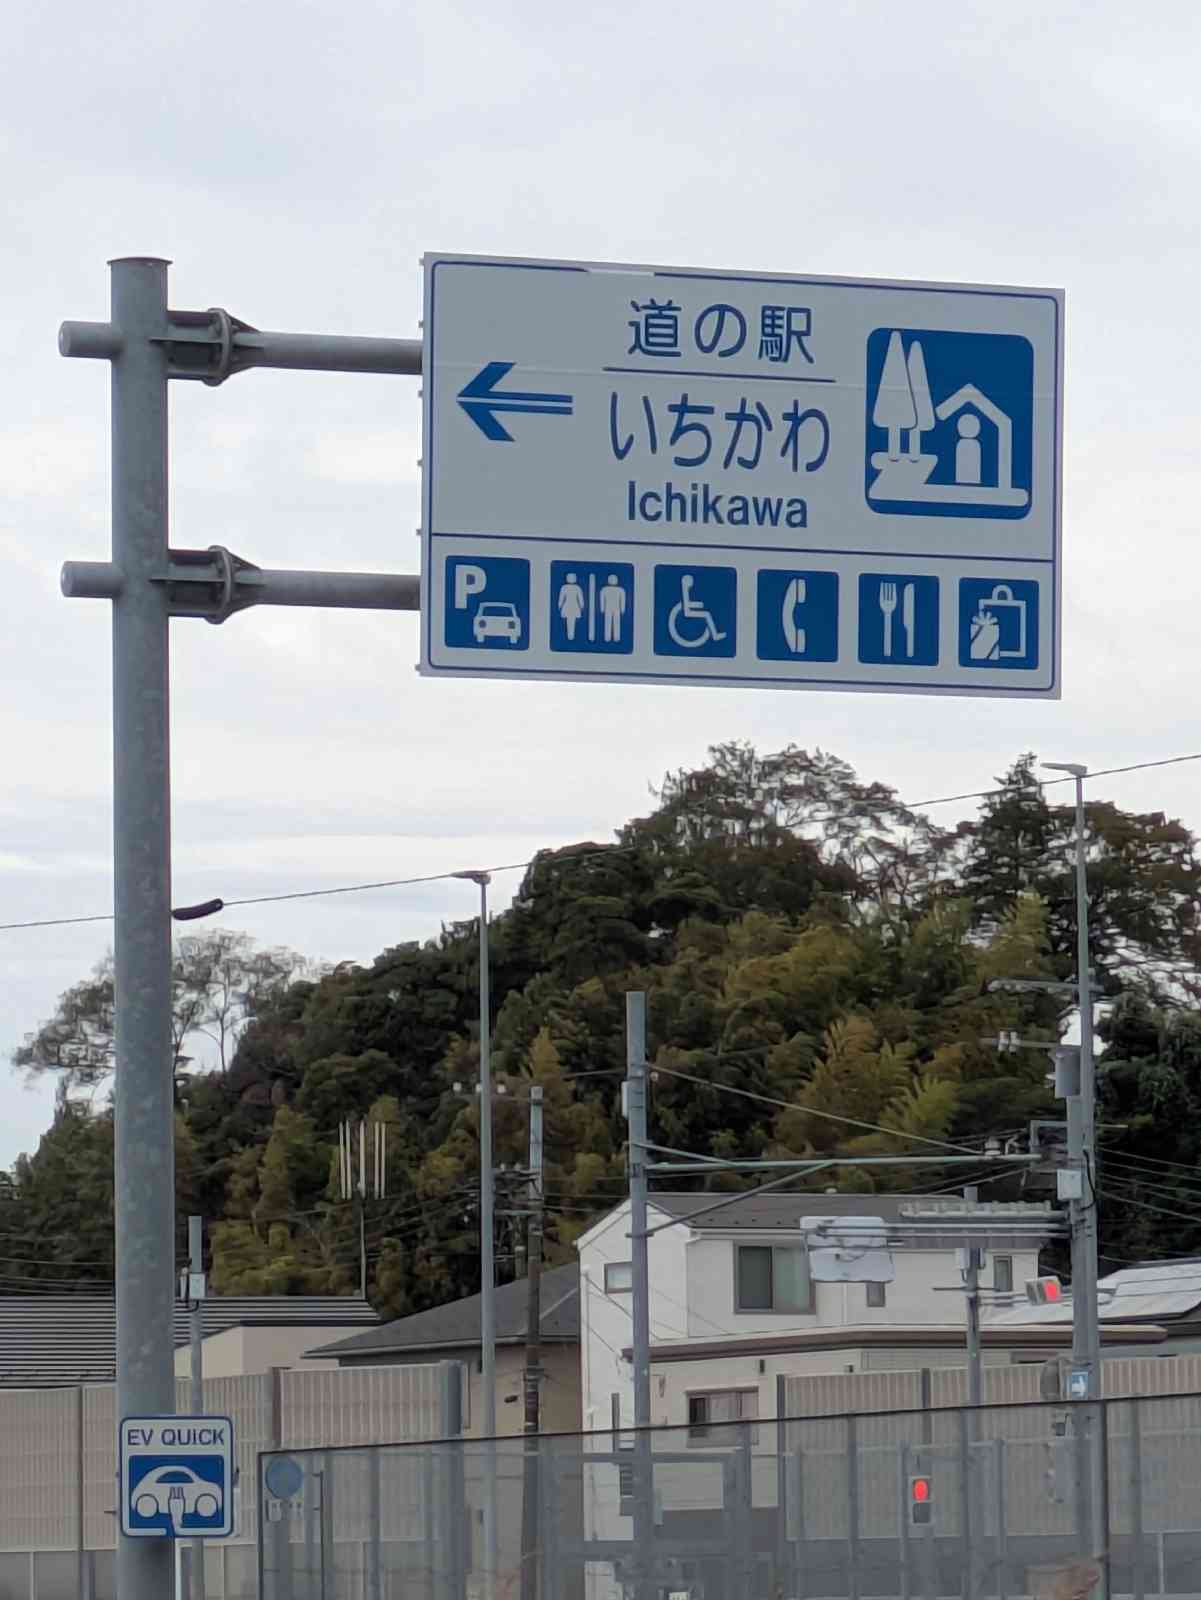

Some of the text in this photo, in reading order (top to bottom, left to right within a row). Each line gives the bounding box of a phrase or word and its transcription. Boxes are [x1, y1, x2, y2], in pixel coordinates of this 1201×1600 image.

[627, 298, 815, 364] 道の駅
[609, 391, 831, 473] いちかわ
[627, 480, 809, 529] Ichikawa
[454, 564, 487, 609] P
[127, 1428, 225, 1446] EV QUICK
